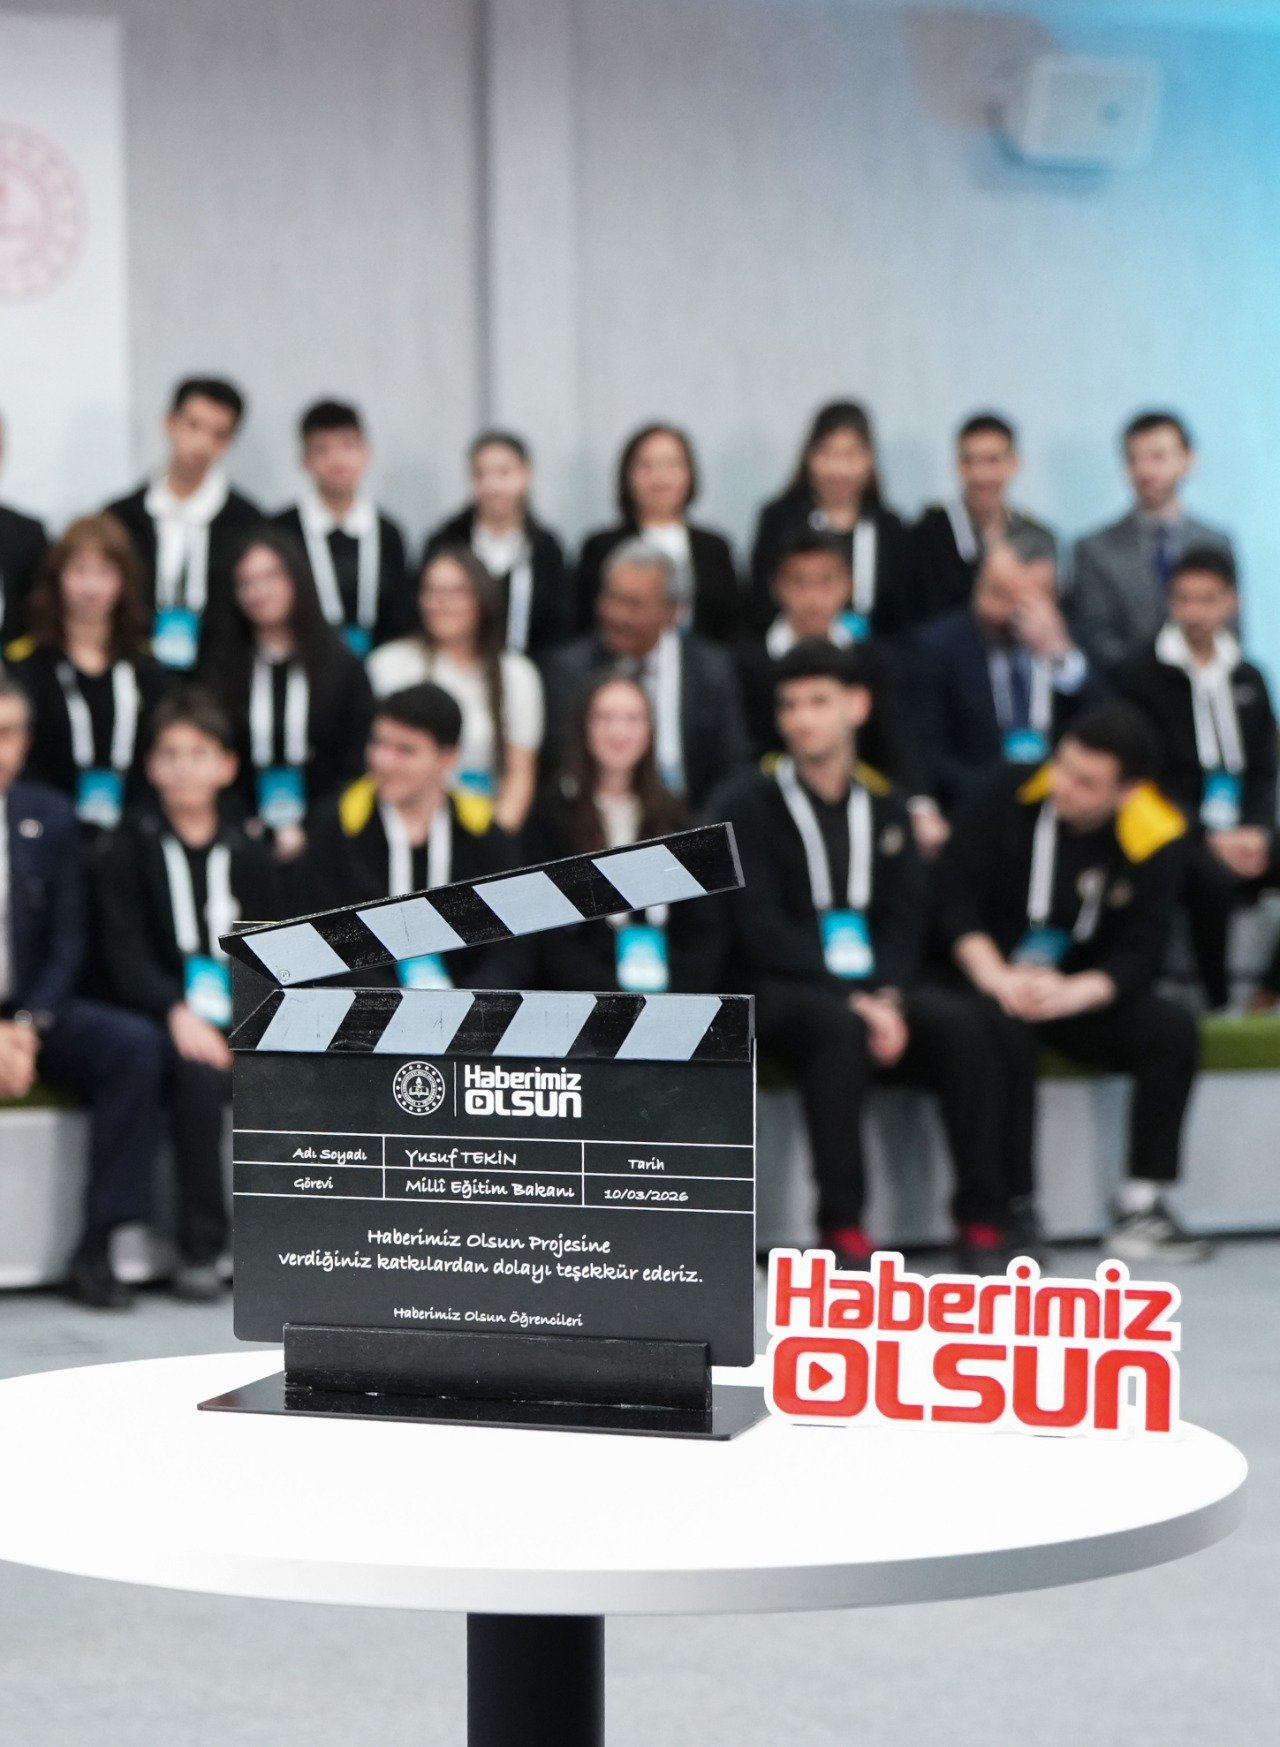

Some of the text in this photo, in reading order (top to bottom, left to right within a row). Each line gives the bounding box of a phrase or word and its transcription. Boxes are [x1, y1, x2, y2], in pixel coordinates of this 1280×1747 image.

[464, 1064, 582, 1091] Haberimiz
[292, 1146, 367, 1165] Adı Soyadı
[404, 1148, 517, 1168] Yusuf TEKİN
[627, 1157, 665, 1171] Tarih
[293, 1176, 334, 1191] Görevi
[405, 1176, 576, 1199] Millî Eğitim Bakanı
[603, 1188, 689, 1202] 10/03/2026
[367, 1227, 611, 1259] Haberimiz Olsun Projesine
[277, 1249, 703, 1284] verdiğiniz katkılardan dolayı teşekkür ederiz.
[774, 1256, 1173, 1342] Haberimiz
[393, 1306, 584, 1328] Haberimiz Olsun Öğrencileri
